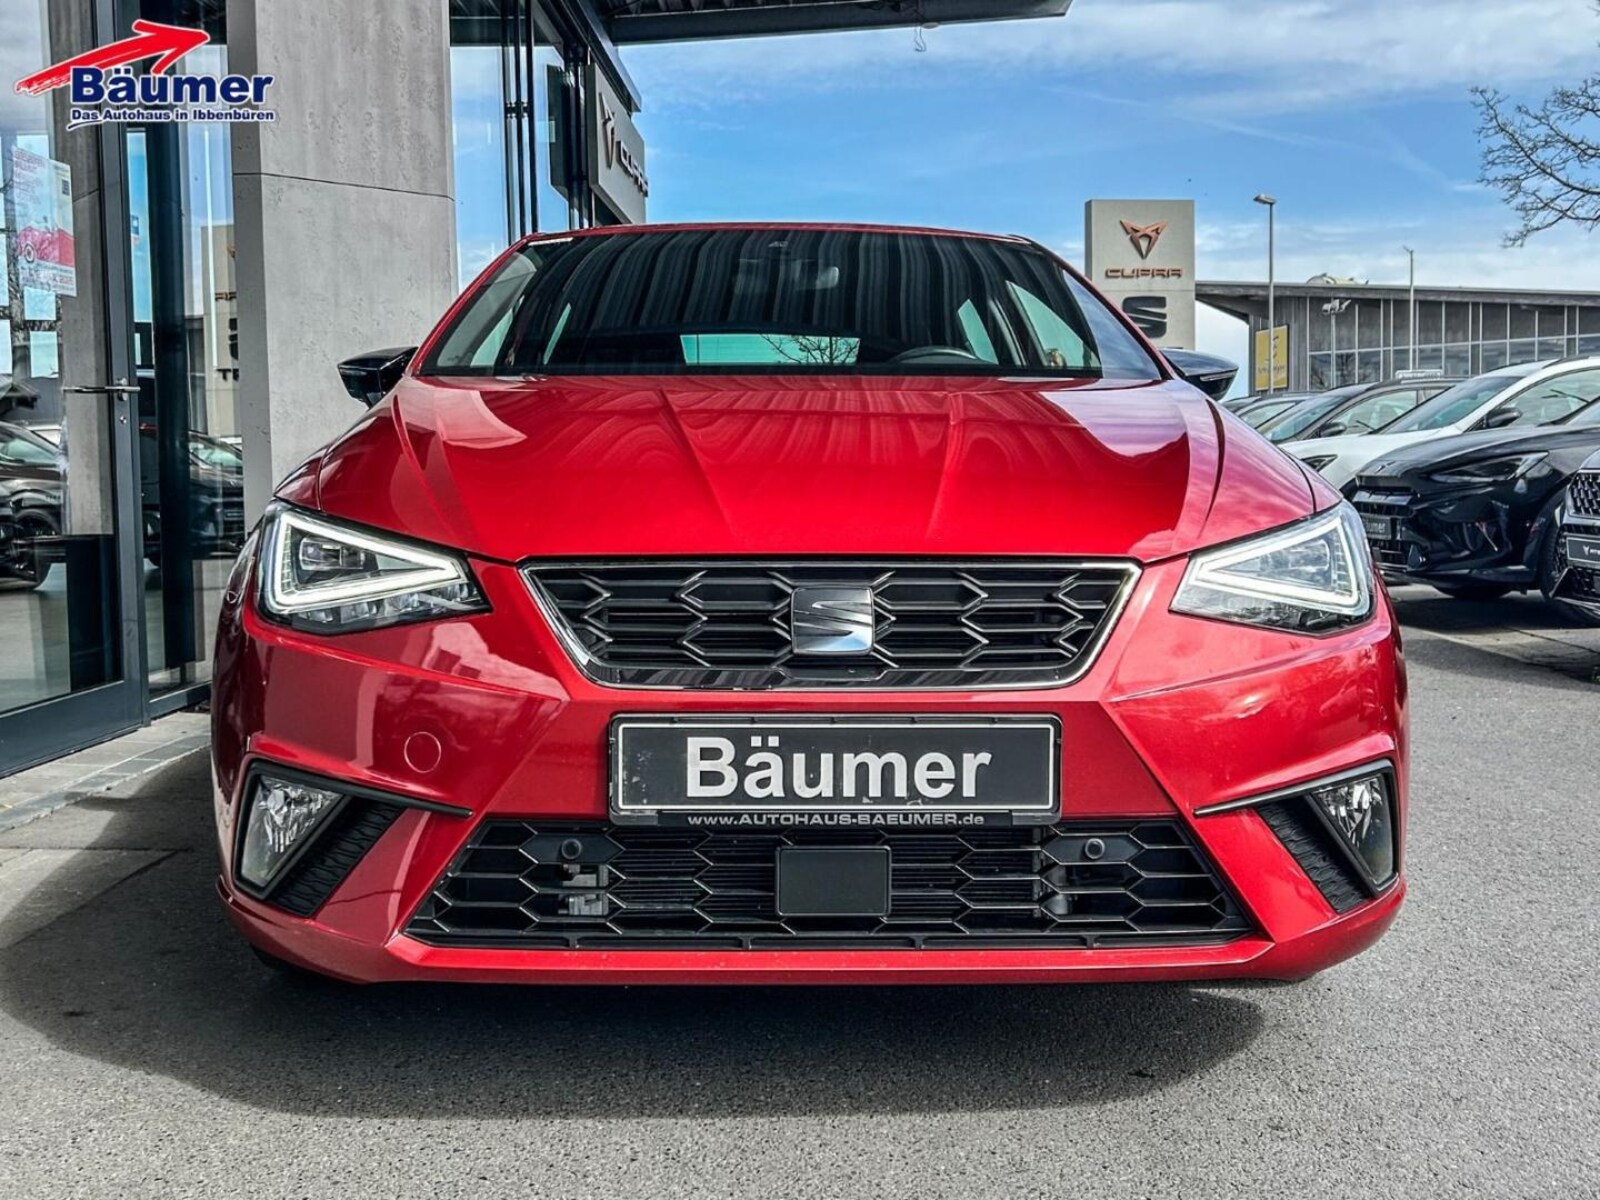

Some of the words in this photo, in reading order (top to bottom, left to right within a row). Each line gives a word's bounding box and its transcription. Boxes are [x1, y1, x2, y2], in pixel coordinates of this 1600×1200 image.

[1105, 268, 1182, 279] CUPRA
[686, 736, 991, 798] Bäumer
[688, 814, 984, 826] www.AUTOHAUS-BAEUMER.de
